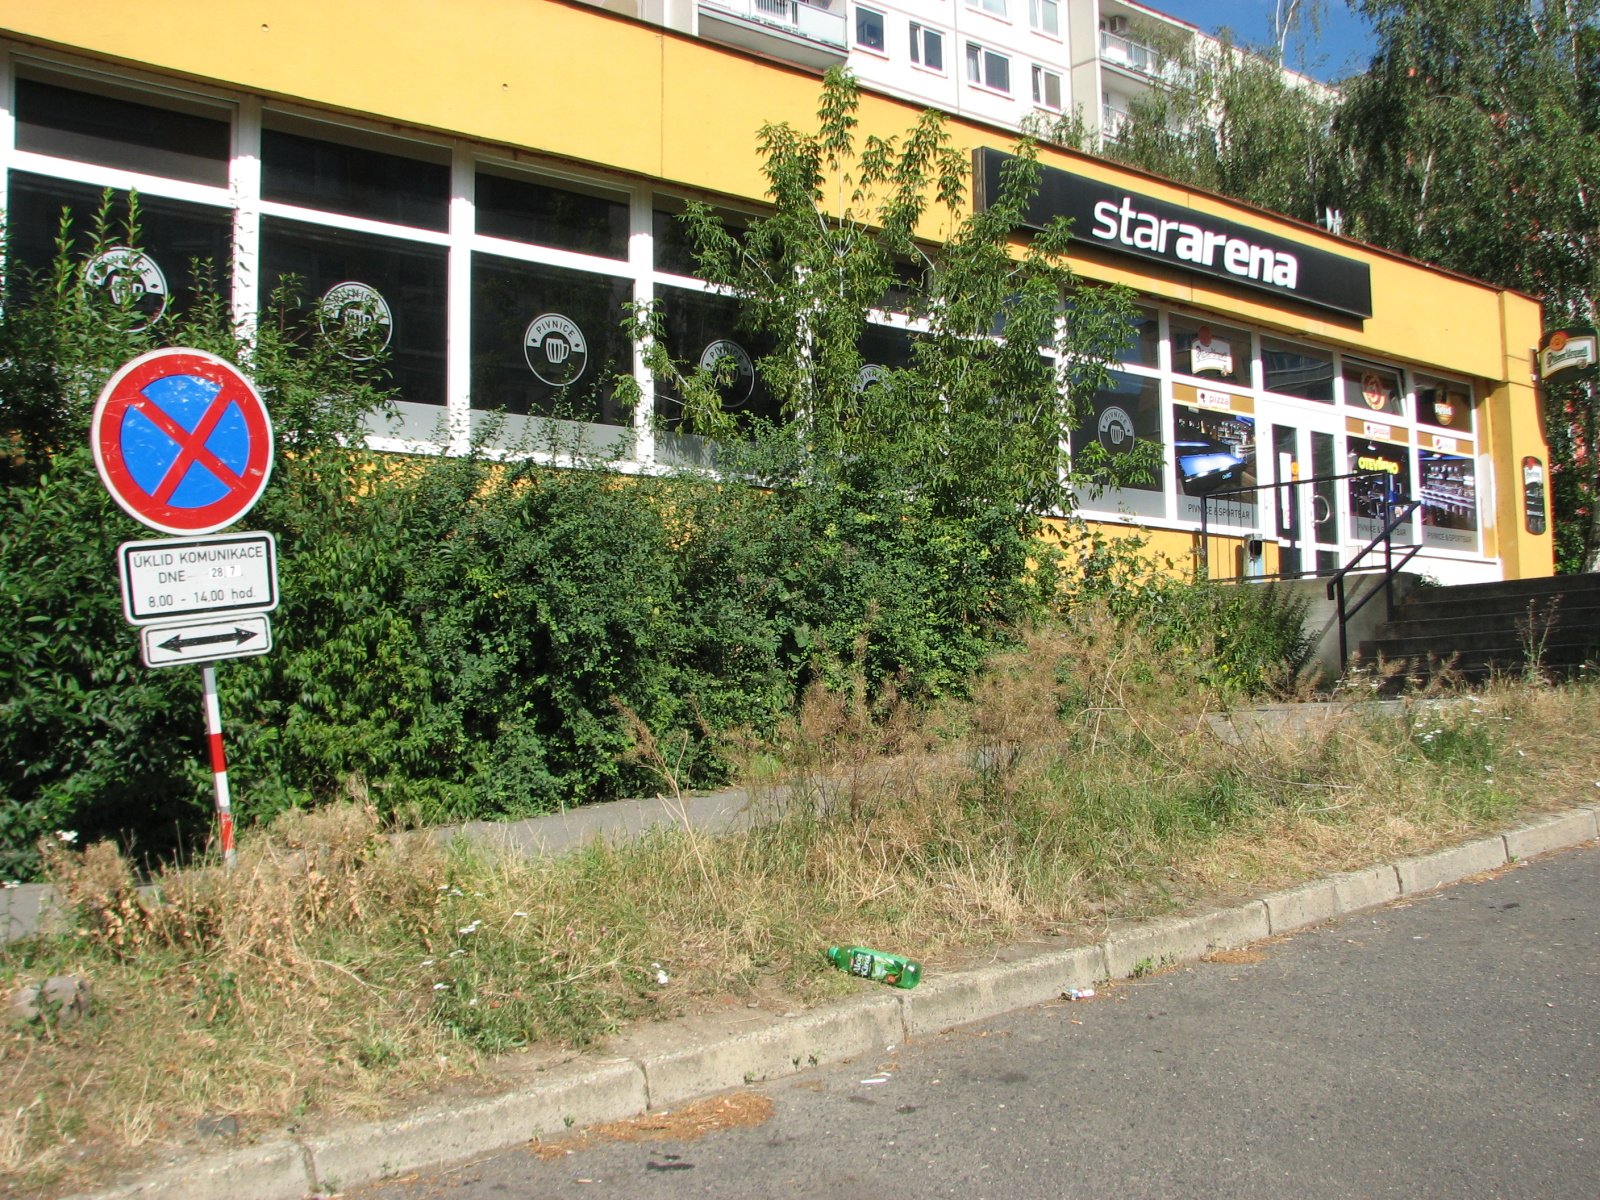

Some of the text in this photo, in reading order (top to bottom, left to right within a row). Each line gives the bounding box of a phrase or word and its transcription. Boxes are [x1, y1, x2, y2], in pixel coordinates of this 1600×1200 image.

[1091, 197, 1298, 290] stararena
[535, 320, 576, 338] PIVNICE
[1104, 411, 1128, 426] PIVNICE
[133, 546, 263, 568] ÚKLID KOMUNIKACE
[158, 570, 186, 584] DNE
[148, 594, 173, 608] 8.00
[194, 589, 224, 603] 14.00
[231, 586, 256, 600] hod.
[853, 954, 863, 974] Aloe
